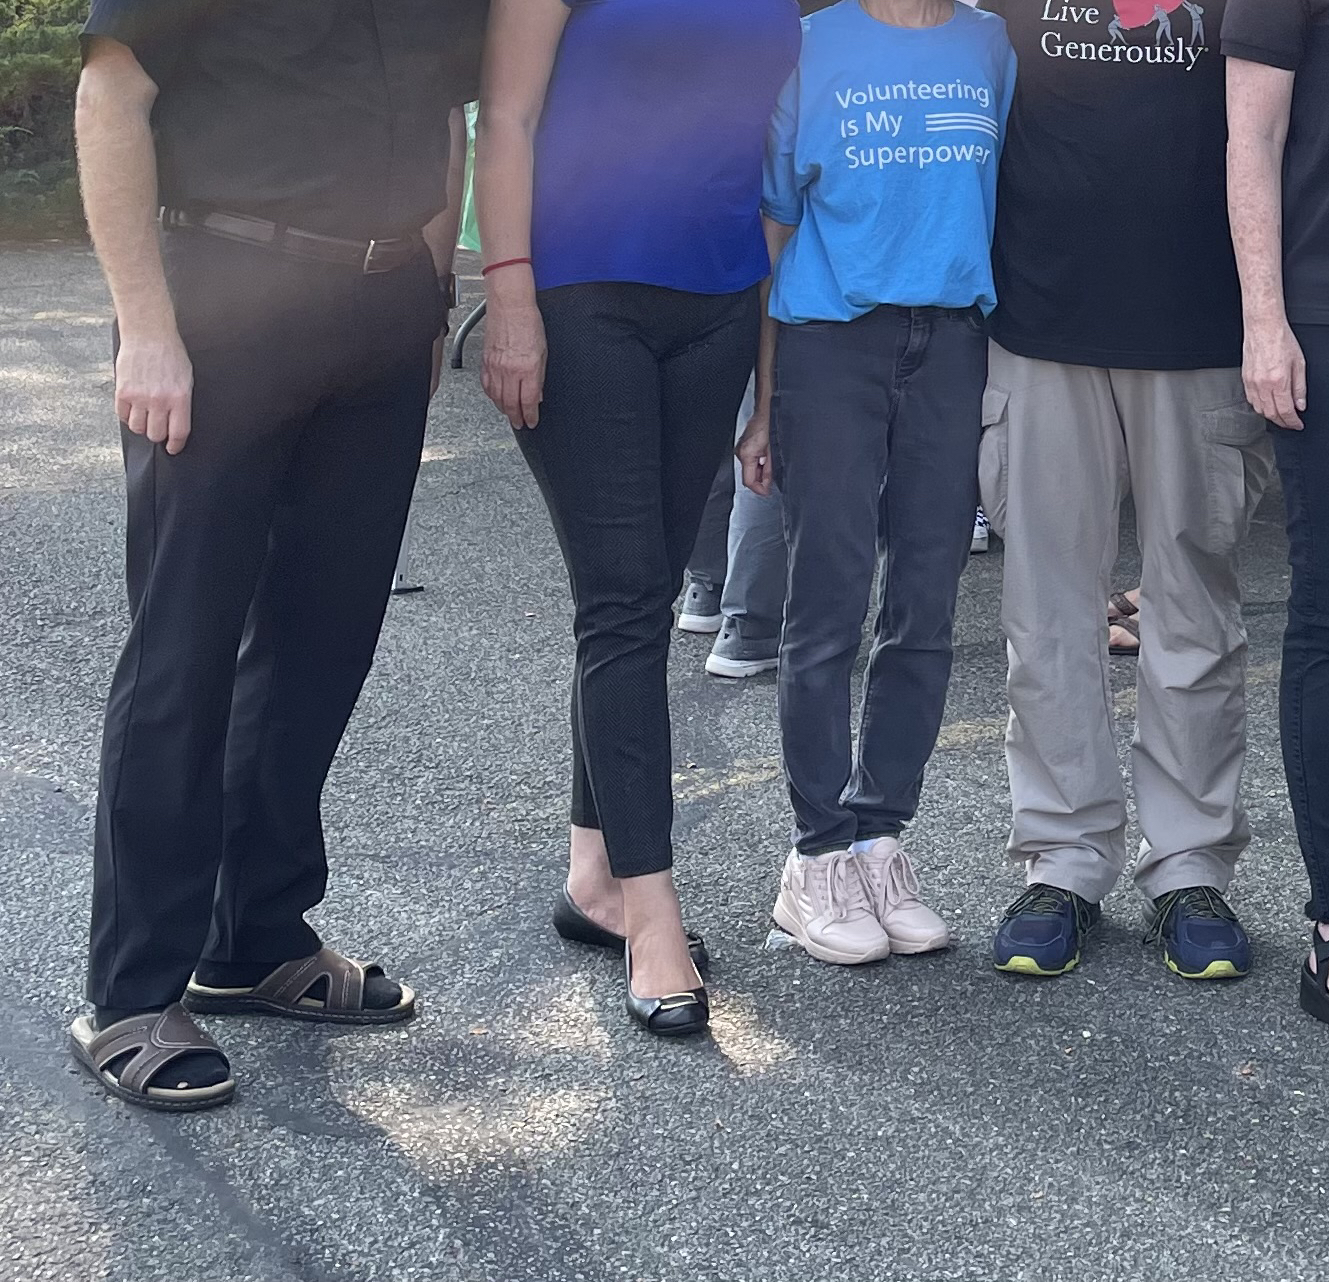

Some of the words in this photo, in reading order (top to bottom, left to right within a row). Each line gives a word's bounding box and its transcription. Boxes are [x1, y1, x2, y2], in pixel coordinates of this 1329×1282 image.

[1041, 31, 1204, 72] Generously
[836, 79, 990, 108] Volunteering
[866, 110, 903, 138] My
[845, 144, 991, 170] Superpower
